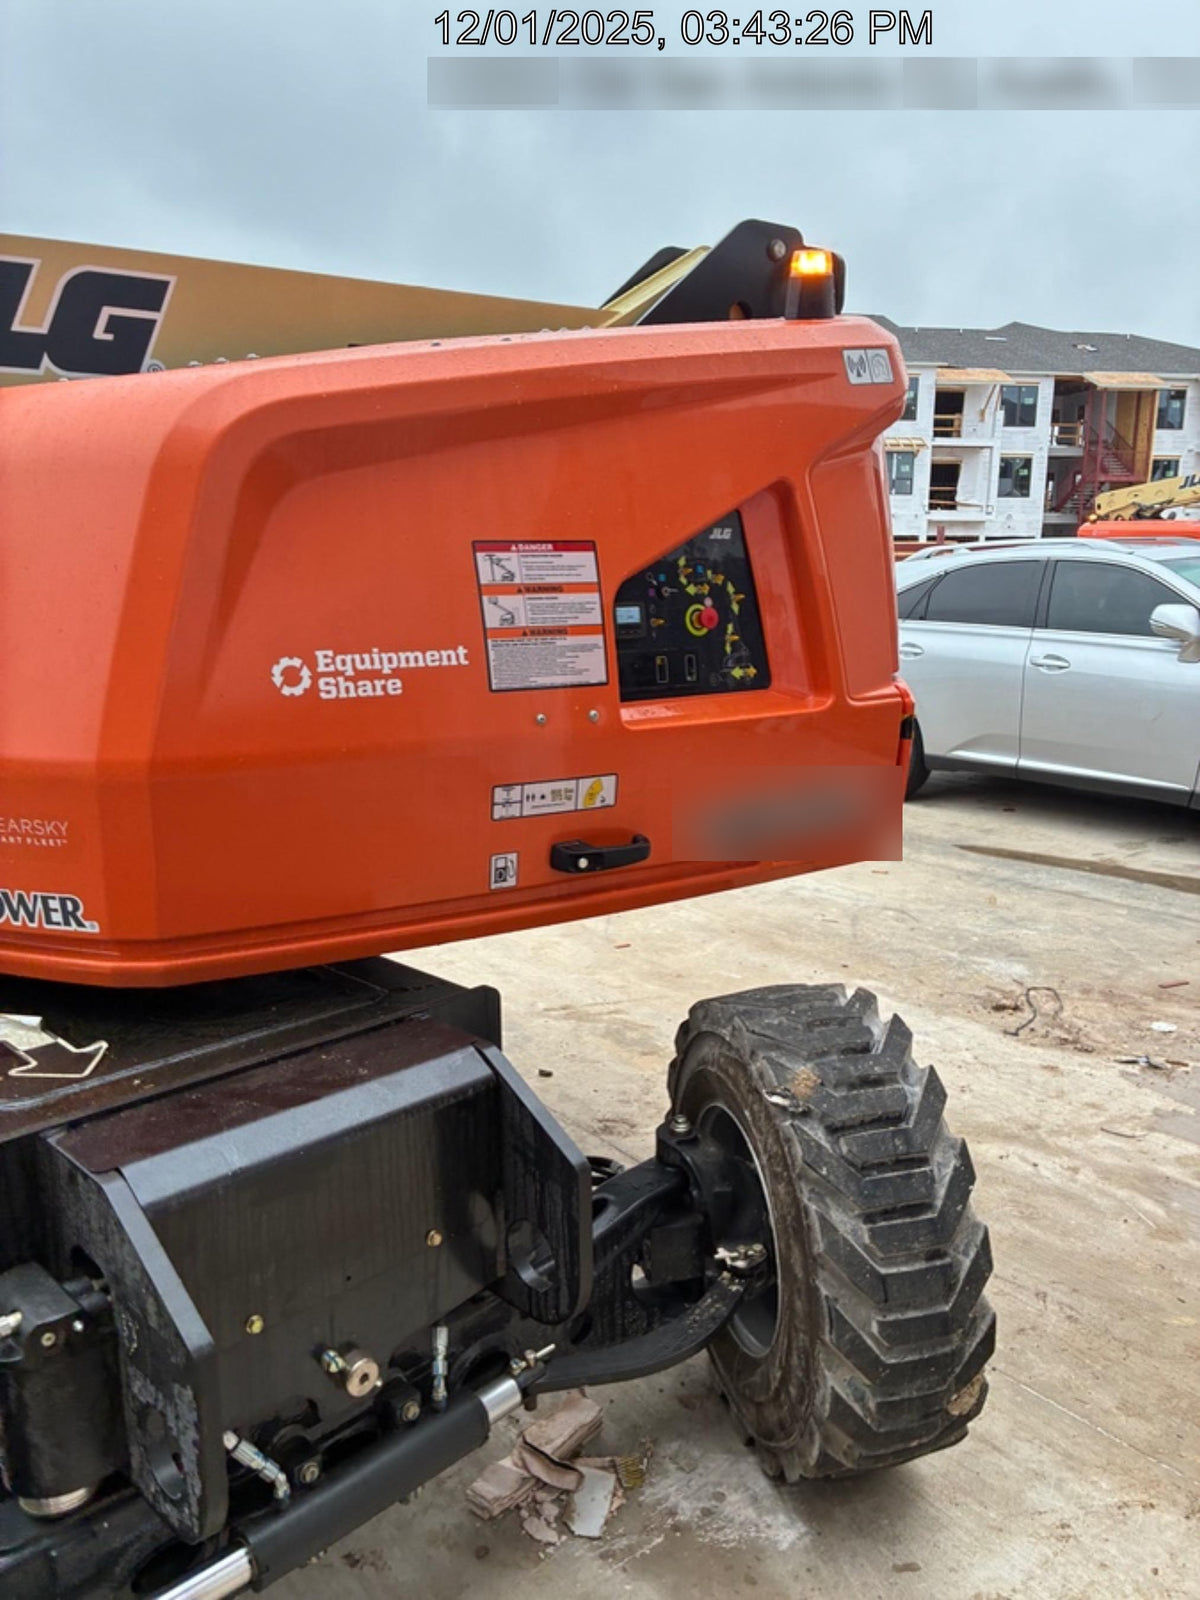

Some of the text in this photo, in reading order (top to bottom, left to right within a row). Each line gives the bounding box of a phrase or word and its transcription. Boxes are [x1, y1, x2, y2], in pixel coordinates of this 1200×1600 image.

[708, 527, 733, 540] JLG
[517, 542, 554, 551] DANGER
[525, 585, 564, 594] WARNING
[529, 626, 568, 636] WARNING
[315, 645, 470, 676] Equipment
[318, 677, 403, 700] Share
